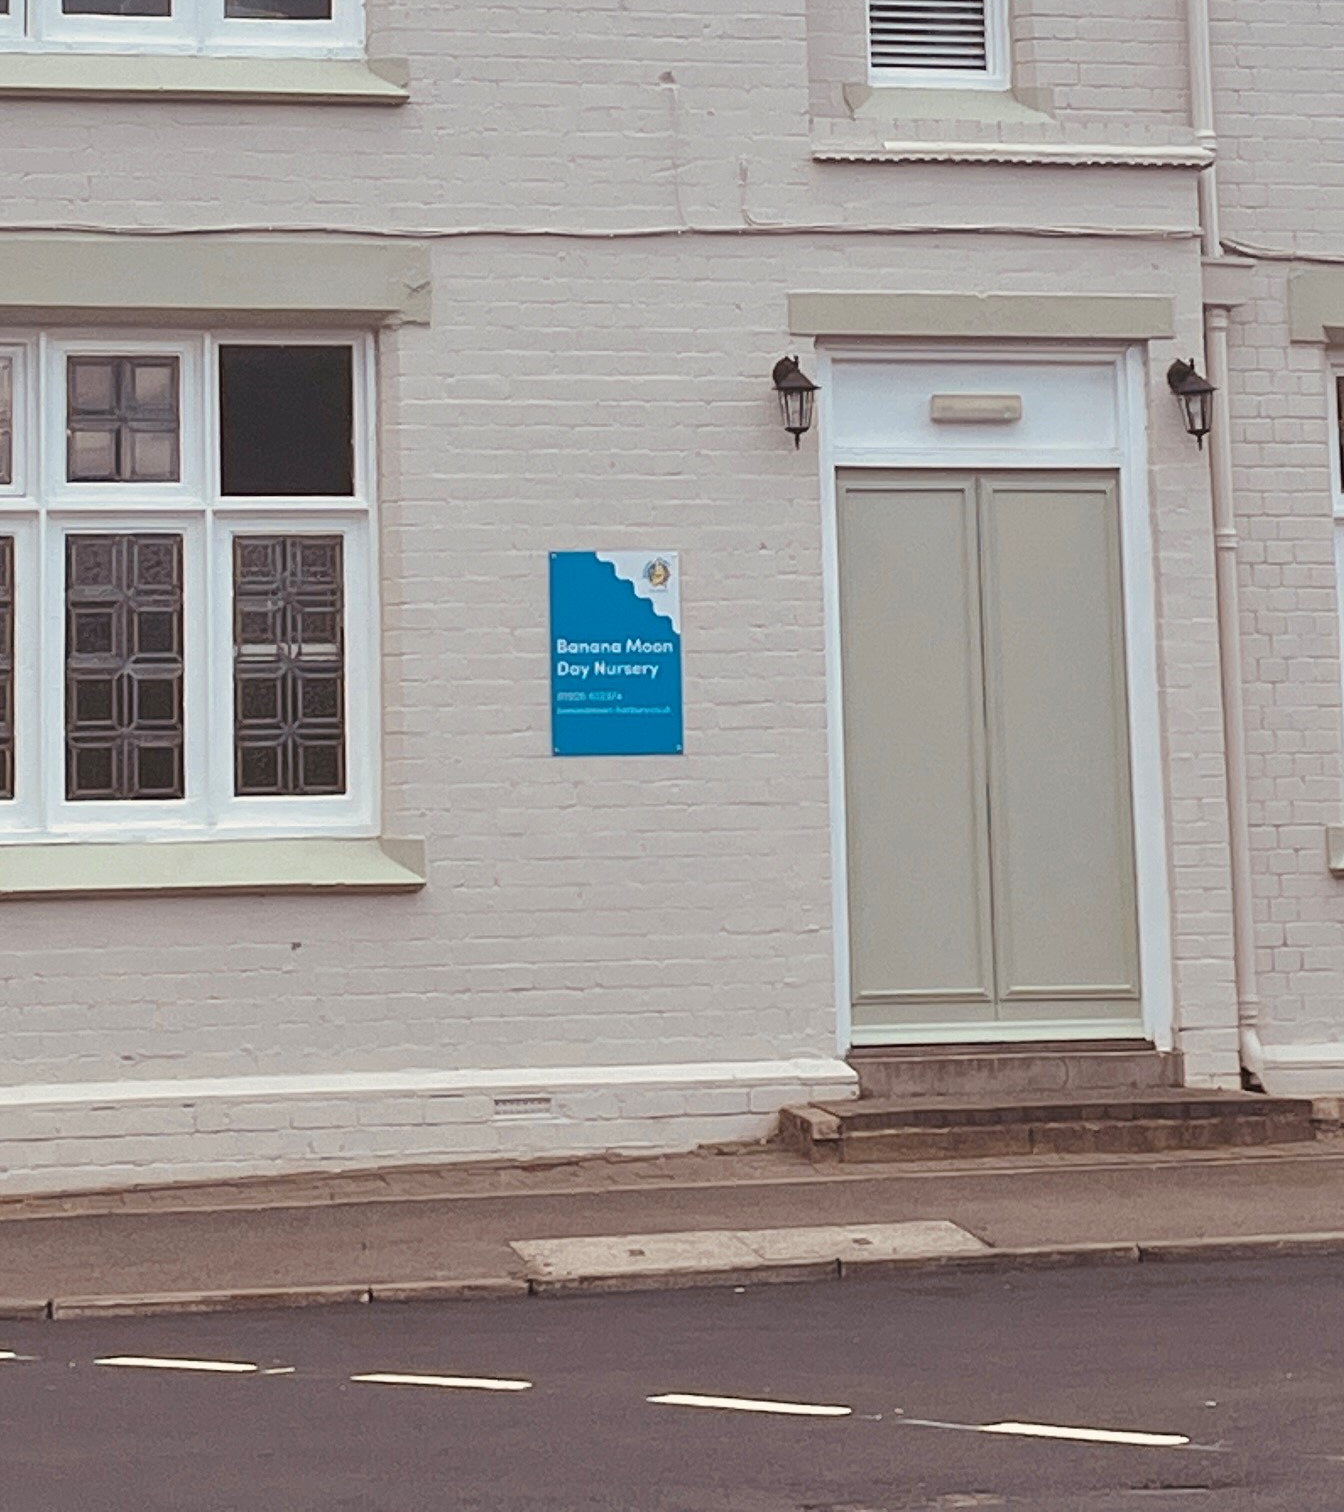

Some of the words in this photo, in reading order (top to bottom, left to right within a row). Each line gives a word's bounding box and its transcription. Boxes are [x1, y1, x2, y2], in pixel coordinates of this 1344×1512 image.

[557, 638, 622, 654] Banana
[626, 638, 674, 653] Moon
[557, 660, 590, 680] Day
[594, 660, 659, 679] Nursery
